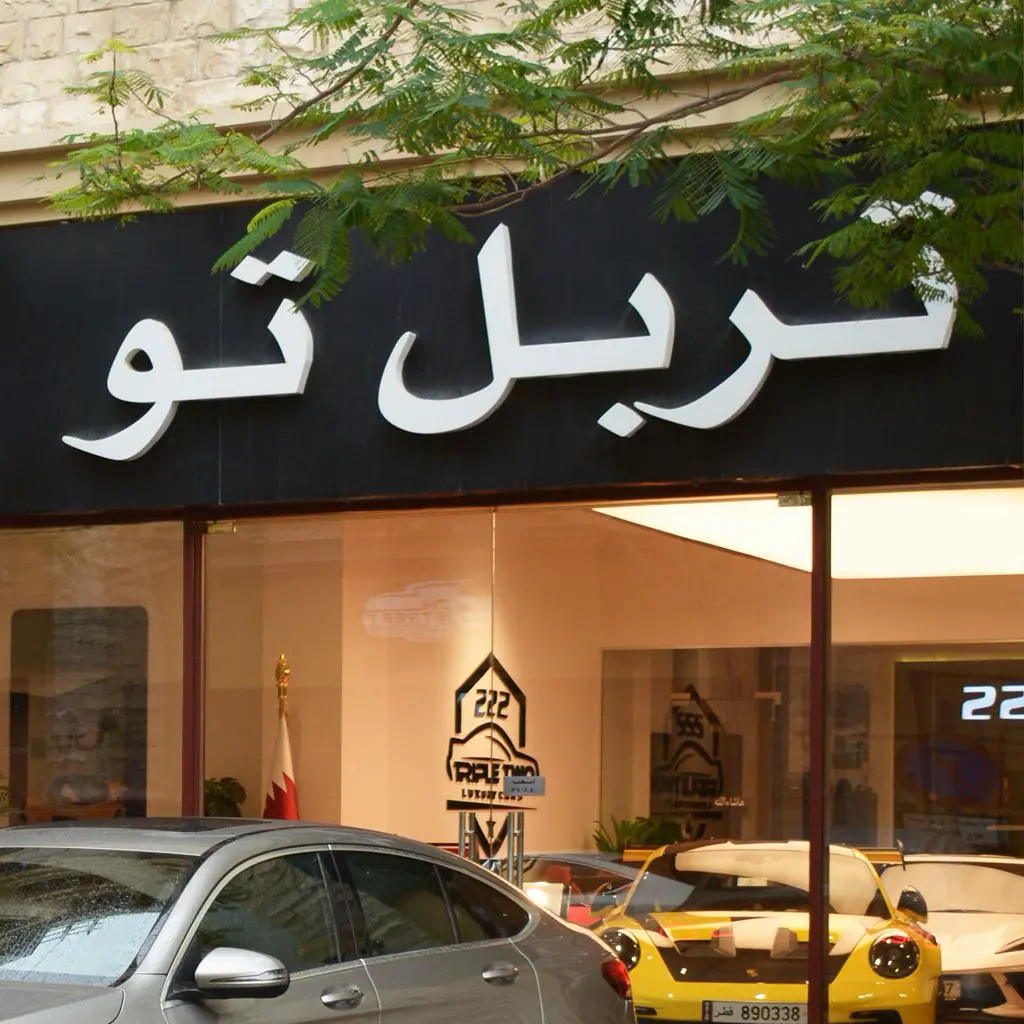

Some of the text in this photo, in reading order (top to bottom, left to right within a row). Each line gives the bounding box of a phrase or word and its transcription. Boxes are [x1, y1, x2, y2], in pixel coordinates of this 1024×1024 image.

[61, 250, 316, 461] تو
[473, 688, 510, 719] 222
[961, 685, 1024, 721] 22
[453, 761, 501, 784] TRIPLE
[714, 1005, 734, 1017] قطر
[740, 1005, 801, 1021] 890338
